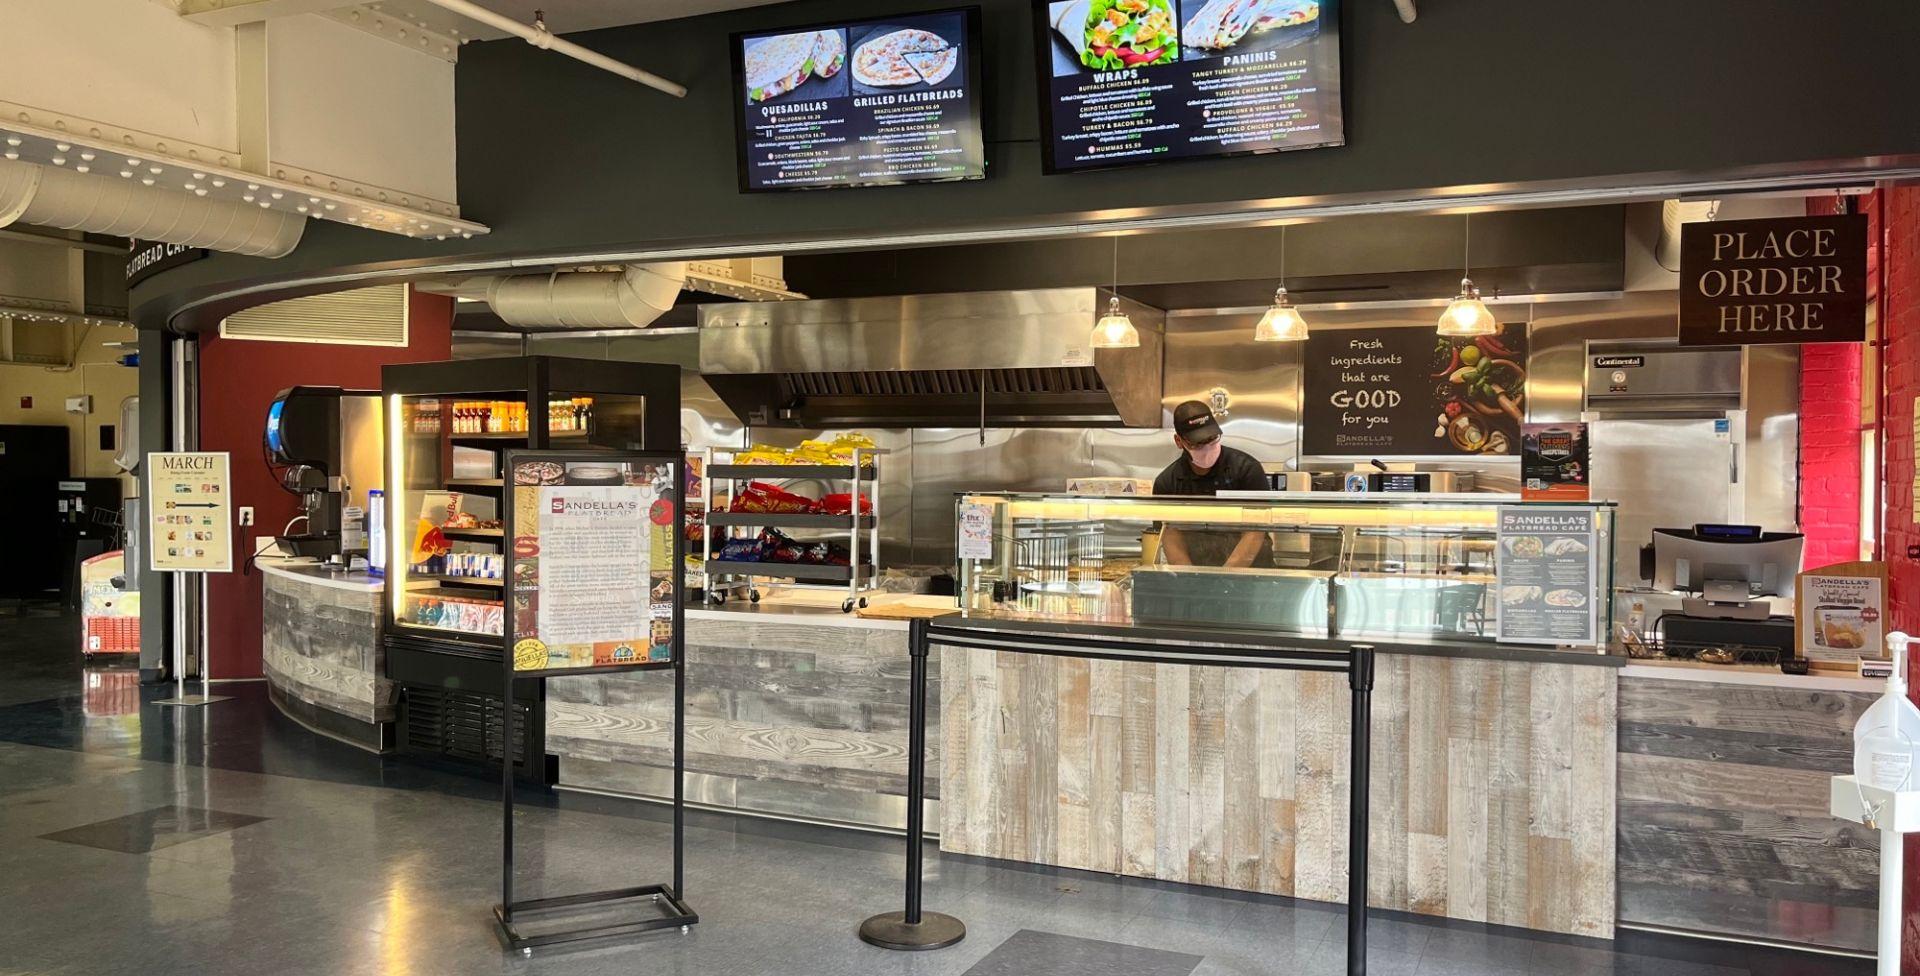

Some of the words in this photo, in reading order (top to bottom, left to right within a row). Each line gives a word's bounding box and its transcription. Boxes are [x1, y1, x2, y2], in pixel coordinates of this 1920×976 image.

[1223, 51, 1277, 66] PANINIS
[1093, 69, 1138, 83] WRAPS
[1078, 83, 1105, 92] BUFFALO
[1106, 81, 1132, 89] CHICKEN
[1241, 86, 1269, 94] CHICKEN
[853, 95, 896, 107] GRILLED
[898, 89, 964, 103] FLATBREADS
[762, 102, 828, 117] QUESADILLAS
[1079, 104, 1108, 113] CHIPOTLE
[1212, 107, 1248, 116] PROVOLONE
[1082, 124, 1106, 132] TURKEY
[1217, 126, 1246, 134] BUFFALO
[1246, 123, 1274, 131] CHICKEN
[1096, 144, 1124, 152] HUMMAS
[1713, 229, 1836, 260] PLACE
[126, 244, 163, 280] FLATBREAD
[166, 242, 194, 256] CAF
[1699, 266, 1845, 298] ORDER
[1718, 302, 1824, 333] HERE
[1350, 339, 1383, 350] Fresh
[1330, 354, 1402, 368] ingredients
[1598, 357, 1640, 366] Continental
[1342, 372, 1366, 382] that
[1371, 374, 1390, 382] are
[1330, 390, 1401, 408] GOOD
[1342, 412, 1362, 426] for
[1366, 415, 1388, 429] you
[162, 457, 214, 470] MARCH
[552, 500, 636, 510] SANDELLA'S
[1504, 516, 1588, 524] SANDELLA'S
[1812, 578, 1870, 586] SANDELLA'S
[596, 656, 646, 664] FLATBREAD
